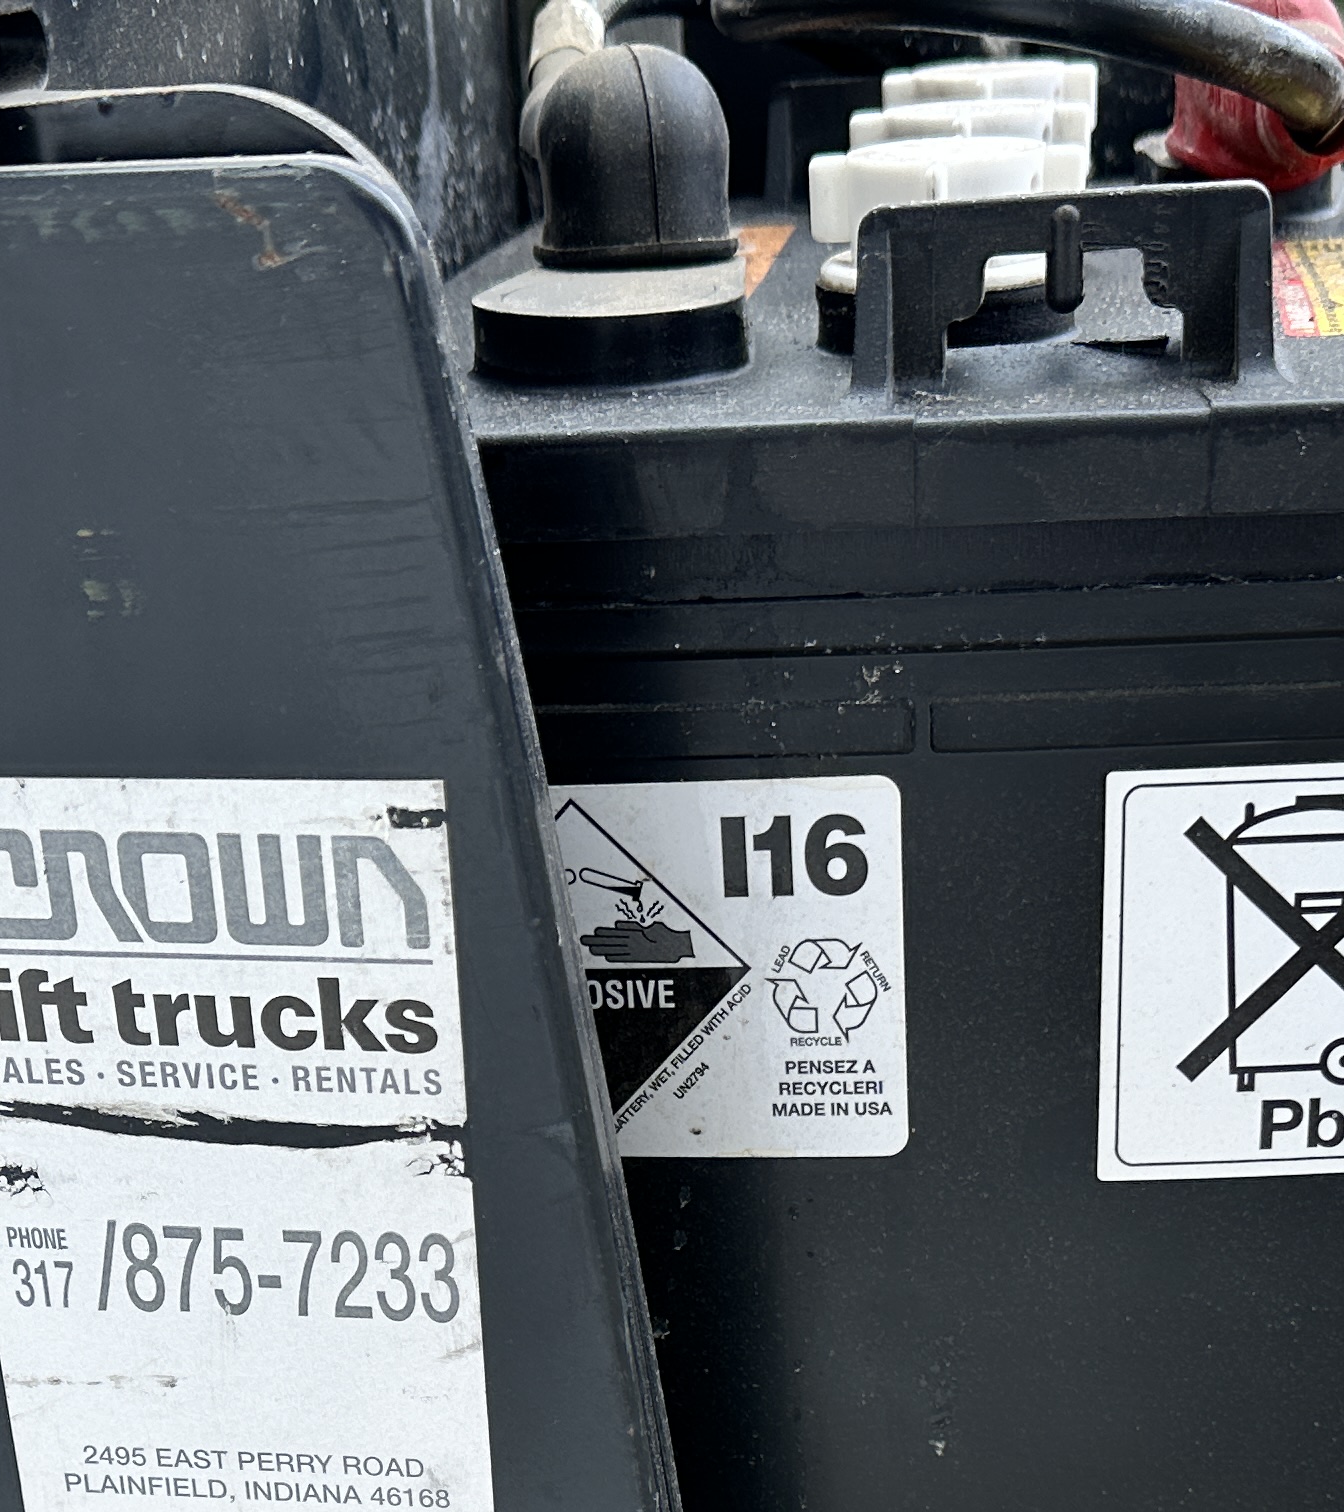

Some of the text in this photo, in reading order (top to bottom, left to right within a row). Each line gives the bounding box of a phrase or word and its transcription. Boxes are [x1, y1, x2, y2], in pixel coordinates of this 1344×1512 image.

[719, 813, 869, 898] I16
[771, 945, 791, 973] LEAD
[859, 951, 891, 992] RETURN
[587, 979, 676, 1009] OSIVE
[111, 977, 439, 1055] trucks
[648, 1067, 676, 1091] WET,
[670, 1034, 704, 1070] FILLED
[701, 1008, 729, 1036] WITH
[726, 983, 752, 1011] ACID
[790, 1036, 843, 1047] RECYCLE
[116, 1060, 260, 1092] SERVICE
[292, 1065, 443, 1097] RENTALS
[673, 1062, 710, 1099] UN2794
[785, 1059, 876, 1075] PENSEZ A
[772, 1101, 893, 1117] MADE IN USA
[5, 1226, 68, 1251] PHONE
[11, 1219, 461, 1324] 317 /875-7233
[82, 1445, 425, 1479] 2495 EAST PERRY ROAD
[64, 1473, 451, 1509] PLAINFIELD, INDIANA 46168
